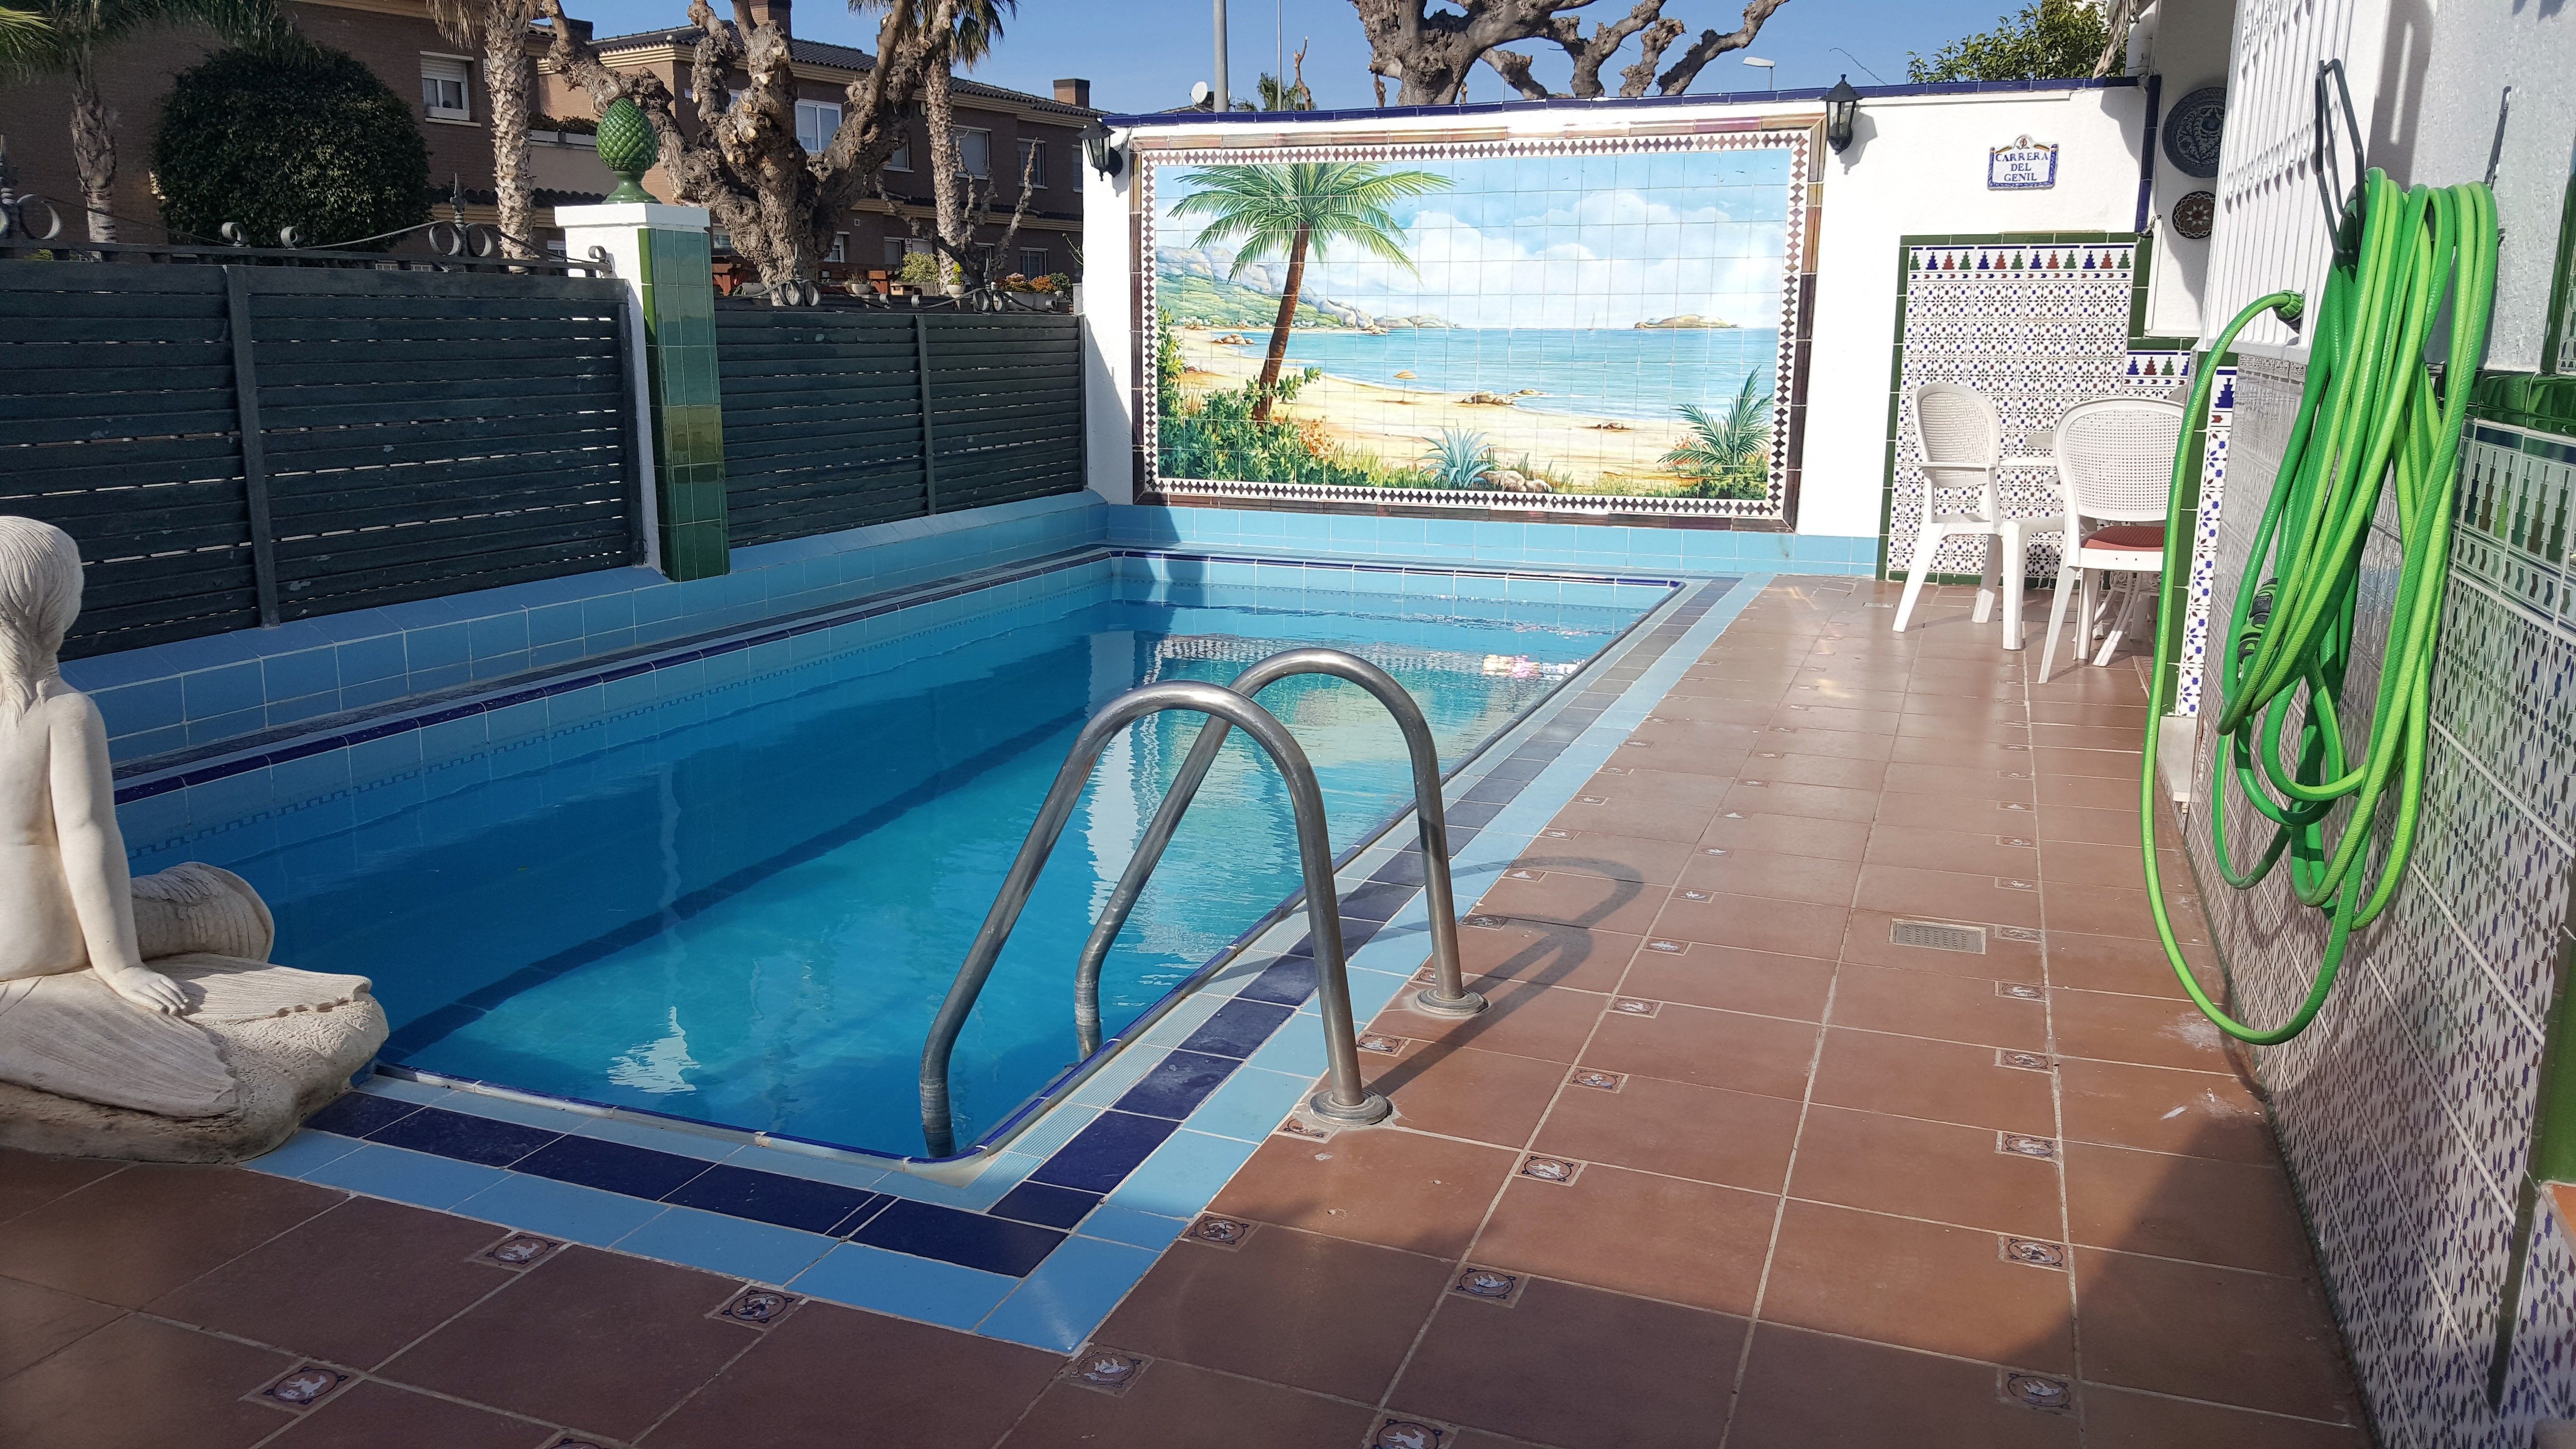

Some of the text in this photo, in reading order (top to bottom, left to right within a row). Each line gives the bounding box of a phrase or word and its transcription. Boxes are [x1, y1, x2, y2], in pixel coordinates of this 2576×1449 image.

[1995, 152, 2049, 162] CARRERA
[2011, 163, 2032, 171] DEL
[2004, 173, 2037, 182] GENIL
